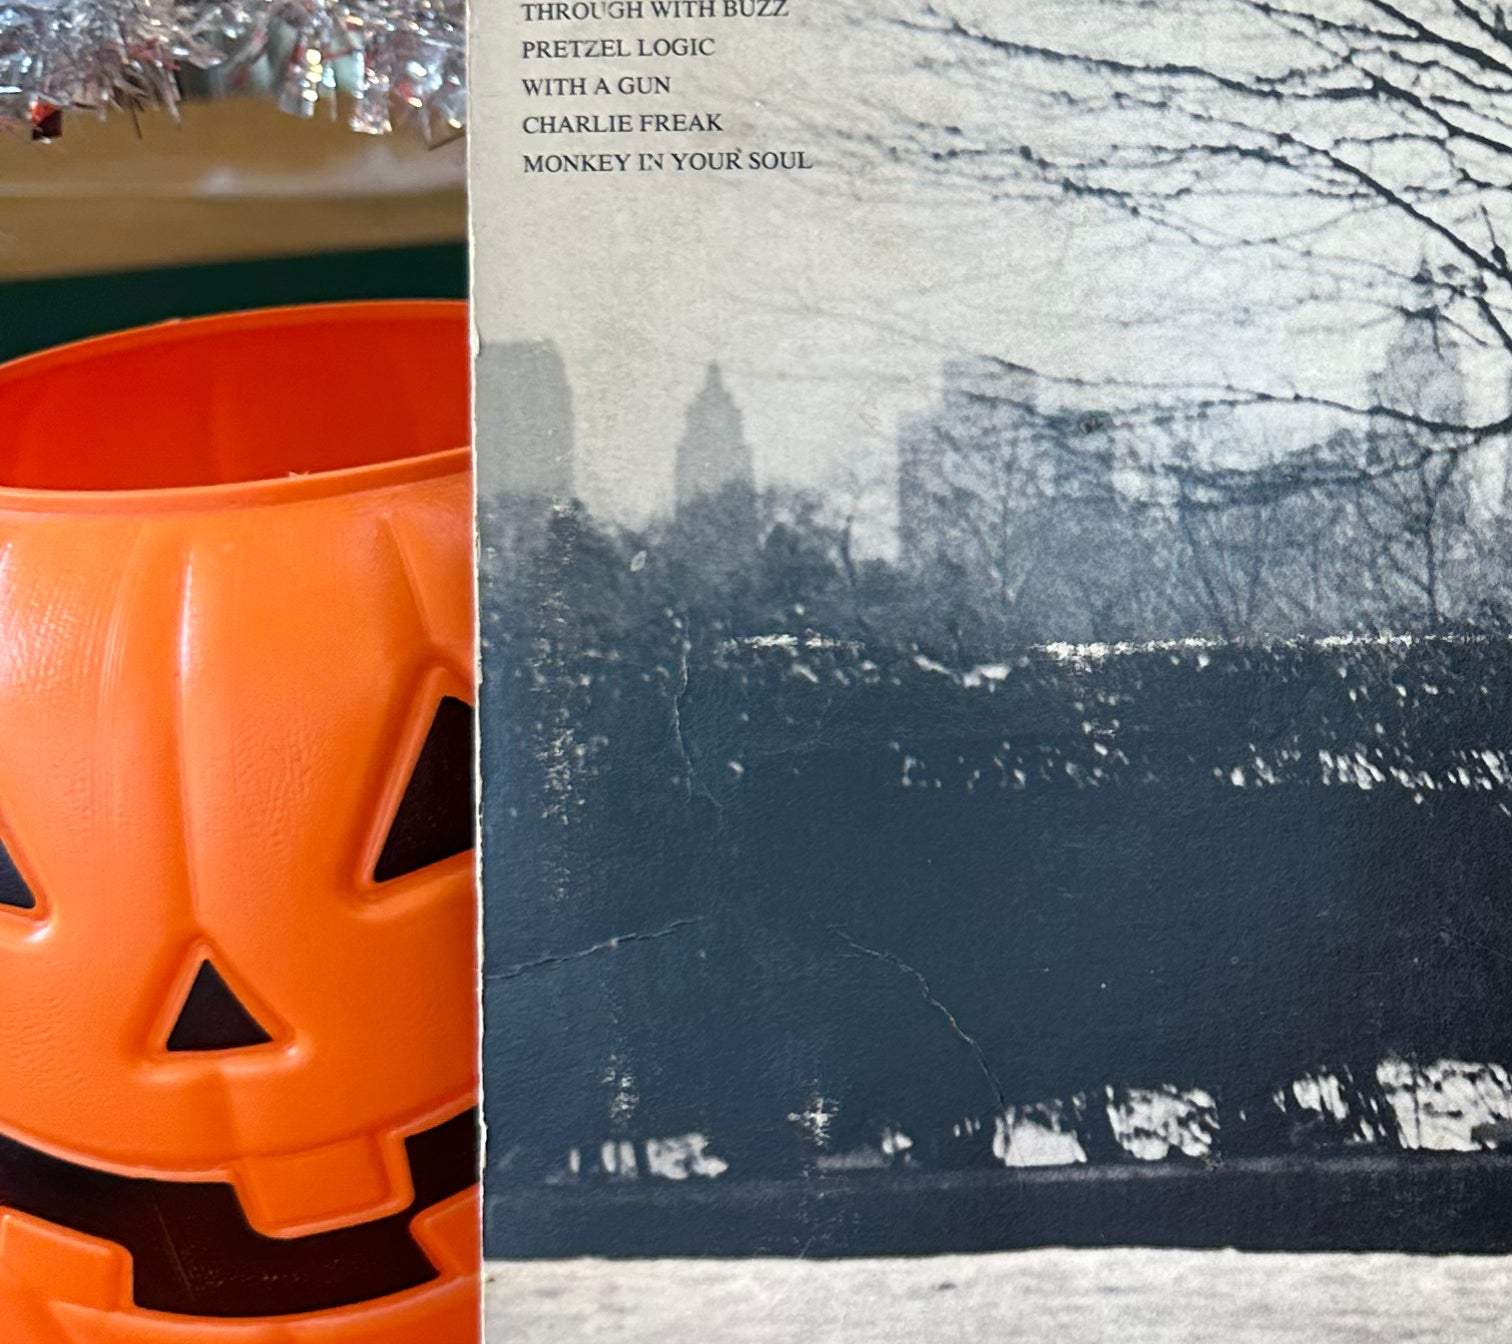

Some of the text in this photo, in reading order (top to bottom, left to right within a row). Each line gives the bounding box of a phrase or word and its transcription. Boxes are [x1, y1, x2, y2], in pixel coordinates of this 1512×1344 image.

[521, 0, 643, 21] THROUGH
[650, 0, 715, 19] WITH
[522, 37, 715, 59] PRETZEL LOGIC
[522, 76, 671, 97] WITH A GUN
[522, 113, 724, 134] CHARLIE FREAK
[523, 151, 813, 173] MONKEY IN YOUR SOUL
